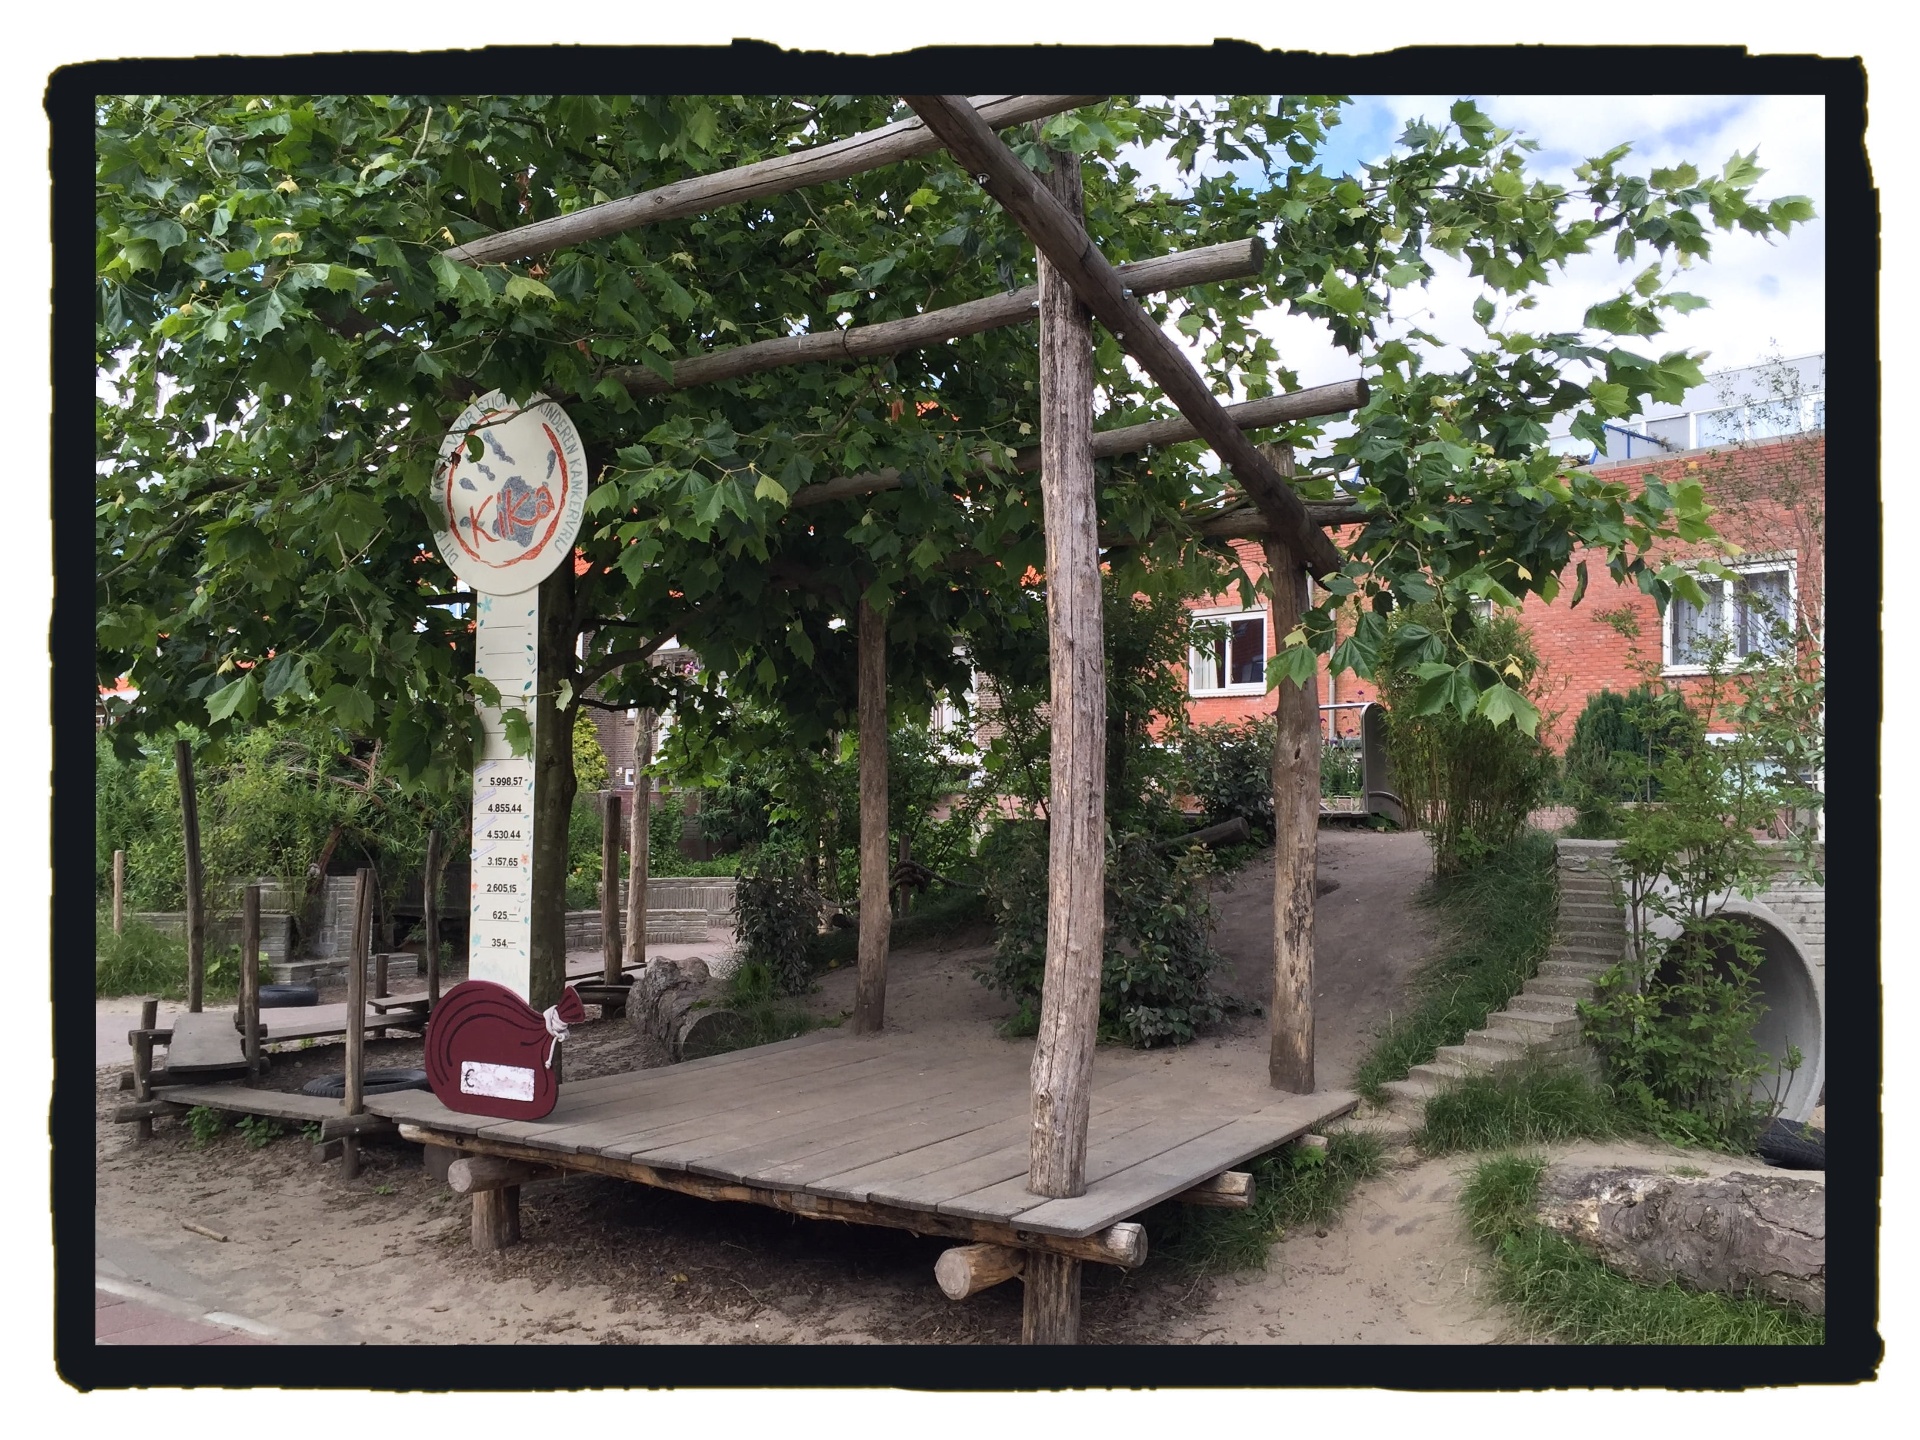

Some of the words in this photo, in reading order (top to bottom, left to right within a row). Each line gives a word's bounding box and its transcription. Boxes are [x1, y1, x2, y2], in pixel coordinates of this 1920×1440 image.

[538, 403, 579, 455] KINDEREN
[554, 458, 583, 554] KANKERVRIJ
[441, 543, 459, 566] DIT
[465, 1069, 475, 1088] €
